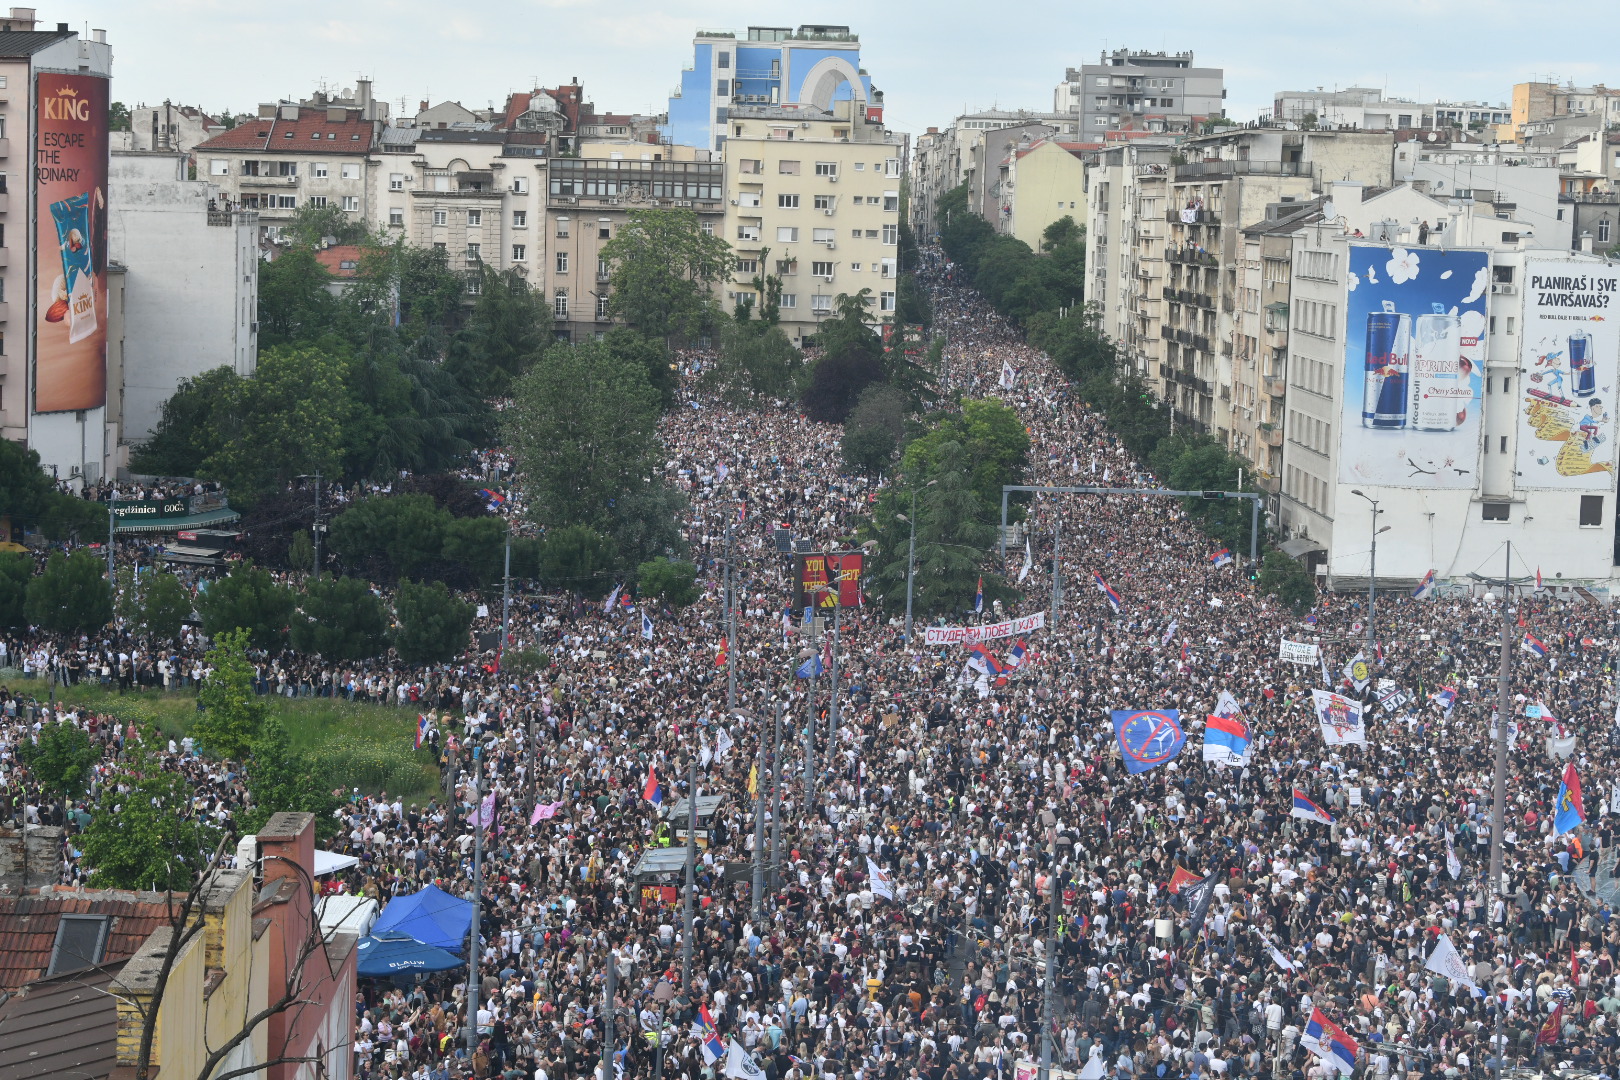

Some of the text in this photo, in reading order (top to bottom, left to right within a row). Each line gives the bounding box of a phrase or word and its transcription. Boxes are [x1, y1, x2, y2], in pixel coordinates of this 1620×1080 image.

[44, 97, 89, 121] KING
[44, 132, 85, 148] ESCAPE
[38, 149, 61, 164] THE
[1531, 274, 1618, 292] PLANIRAŠ I SVE
[1537, 291, 1610, 308] ZAVRŠAVAŠ?
[1367, 352, 1409, 366] Red Bull
[805, 559, 825, 572] YOU
[840, 568, 860, 581] GOT
[927, 627, 981, 643] СТУДЕНИ
[388, 960, 425, 968] BLAUW
